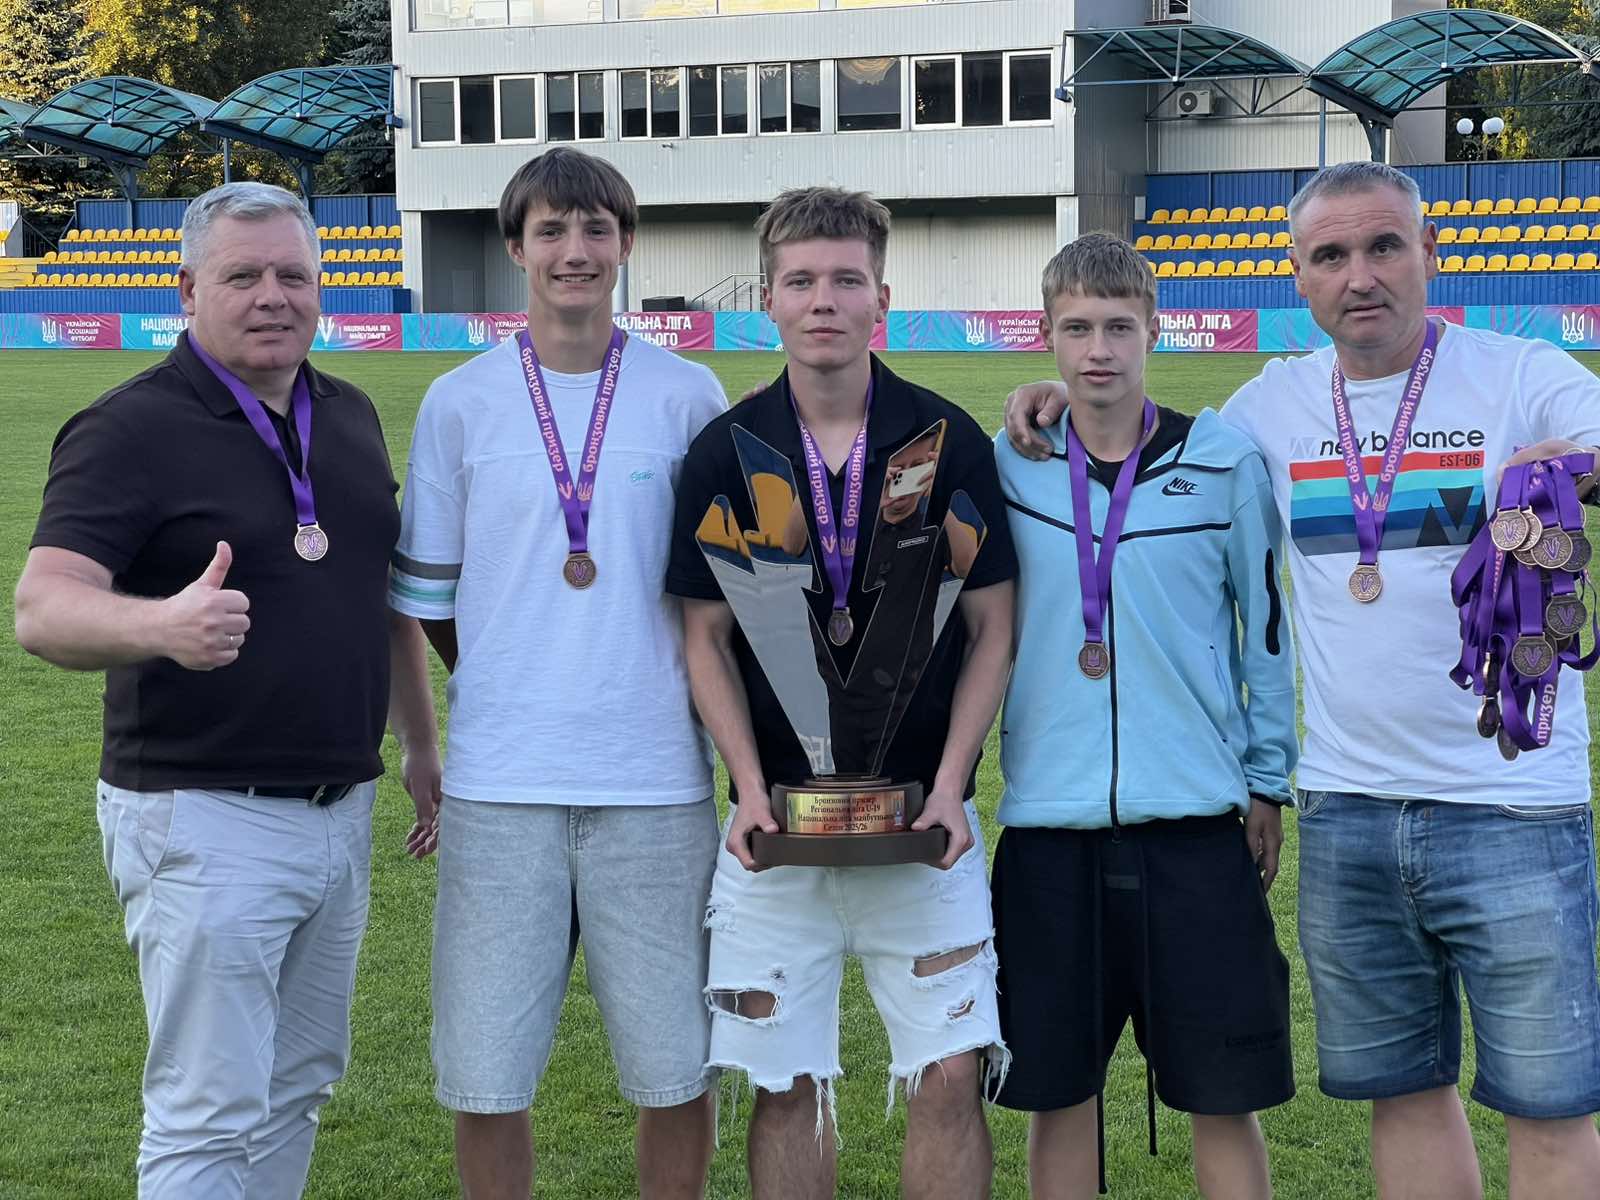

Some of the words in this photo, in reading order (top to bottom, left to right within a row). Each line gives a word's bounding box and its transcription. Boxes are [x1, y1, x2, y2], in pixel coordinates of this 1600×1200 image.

[494, 320, 528, 328] УКРАЇНСЬК
[664, 316, 692, 330] ЛІГА
[1200, 314, 1232, 330] ЛІГА
[1003, 335, 1036, 343] ФУТБОЛУ
[1159, 332, 1215, 348] ТНЬОГО
[522, 346, 553, 420] бронзовий
[542, 420, 564, 473] призер
[583, 397, 609, 473] бронзовий
[602, 347, 621, 397] призер
[1380, 400, 1414, 482] бронзовий
[1410, 347, 1433, 398] призер
[1371, 429, 1485, 452] blance
[1341, 431, 1361, 484] призер
[1439, 453, 1480, 467] EST-06
[843, 445, 864, 528] бронзовий
[1169, 477, 1198, 491] NIKE
[811, 469, 829, 525] призер
[1536, 683, 1556, 739] призер
